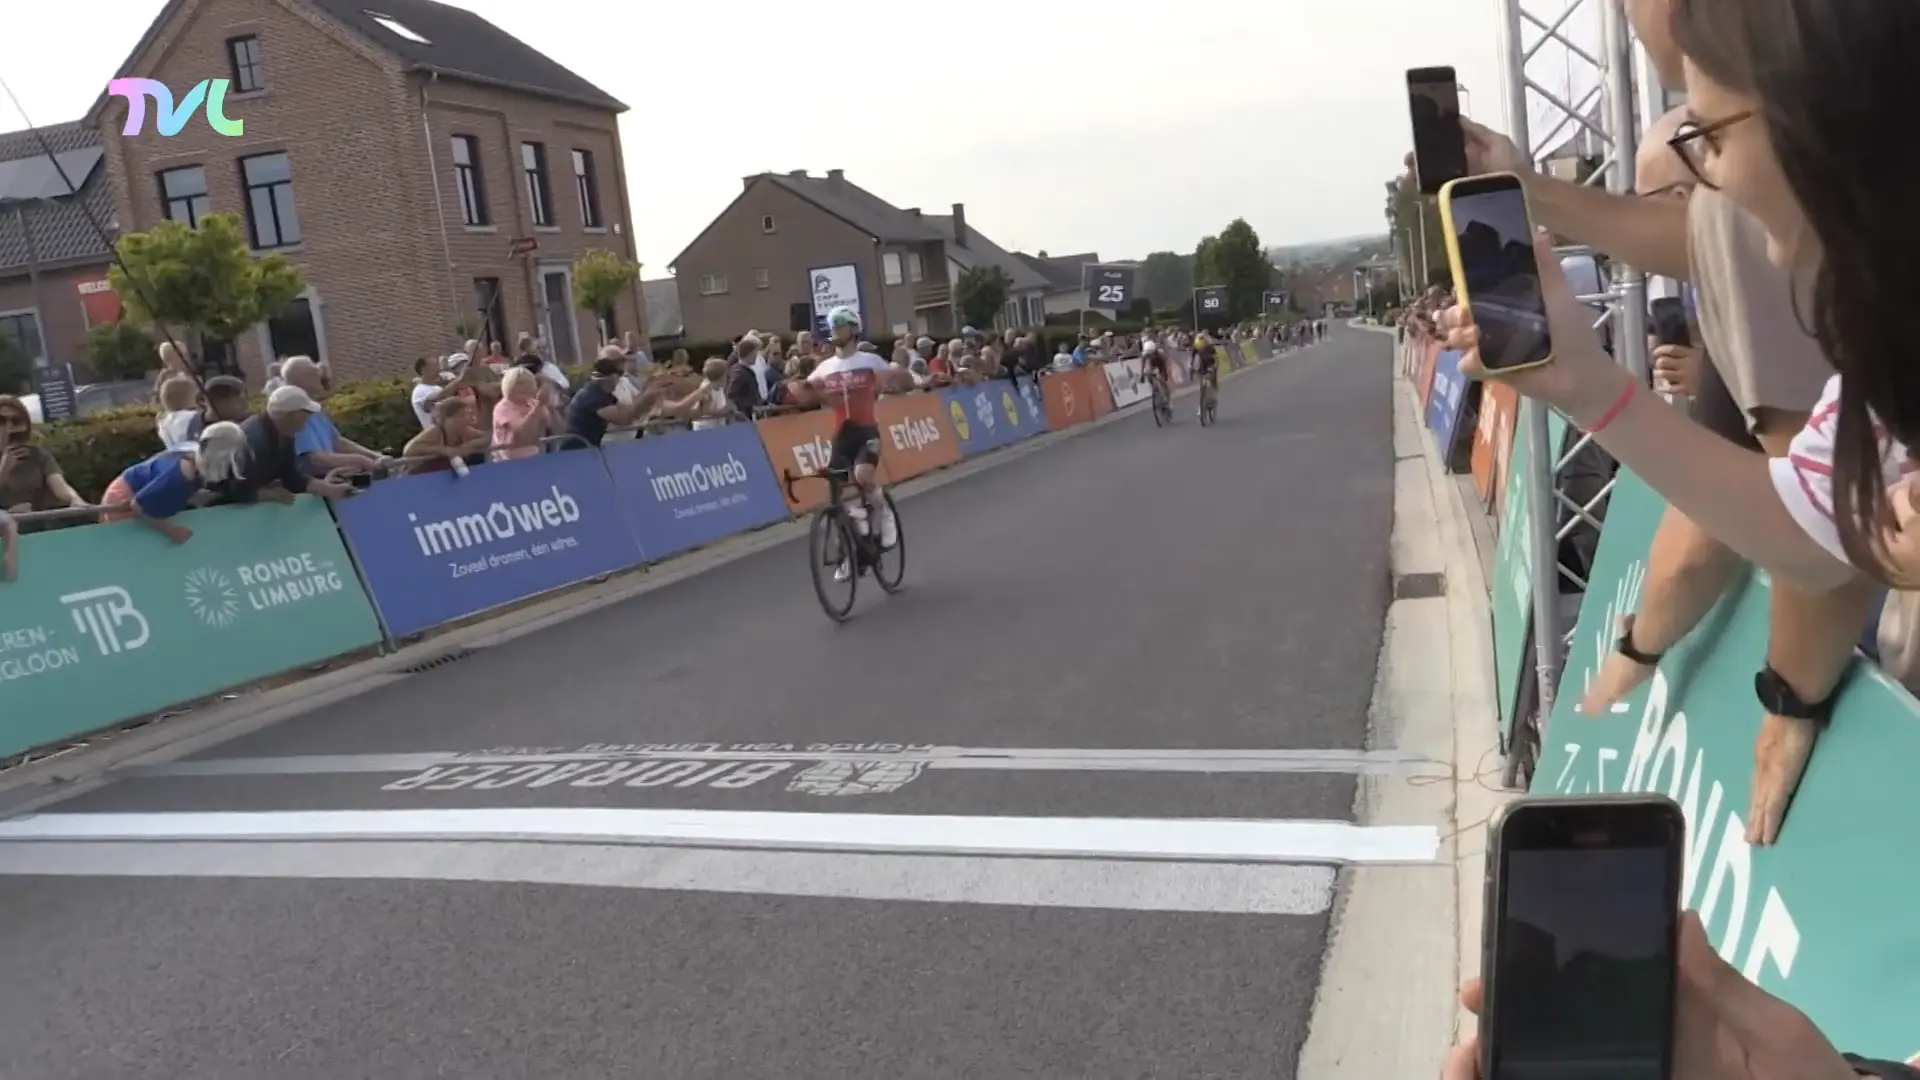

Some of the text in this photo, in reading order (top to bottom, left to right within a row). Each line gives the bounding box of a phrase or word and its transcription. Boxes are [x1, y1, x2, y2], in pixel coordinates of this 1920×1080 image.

[1098, 285, 1124, 302] 25
[1204, 298, 1219, 308] 50
[646, 452, 747, 502] immoweb
[408, 485, 580, 556] immoweb
[237, 552, 316, 586] RONDE
[249, 571, 342, 610] LIMBURG
[0, 625, 56, 651] REN-
[0, 646, 80, 683] GLOON
[380, 760, 796, 790] BIORACER
